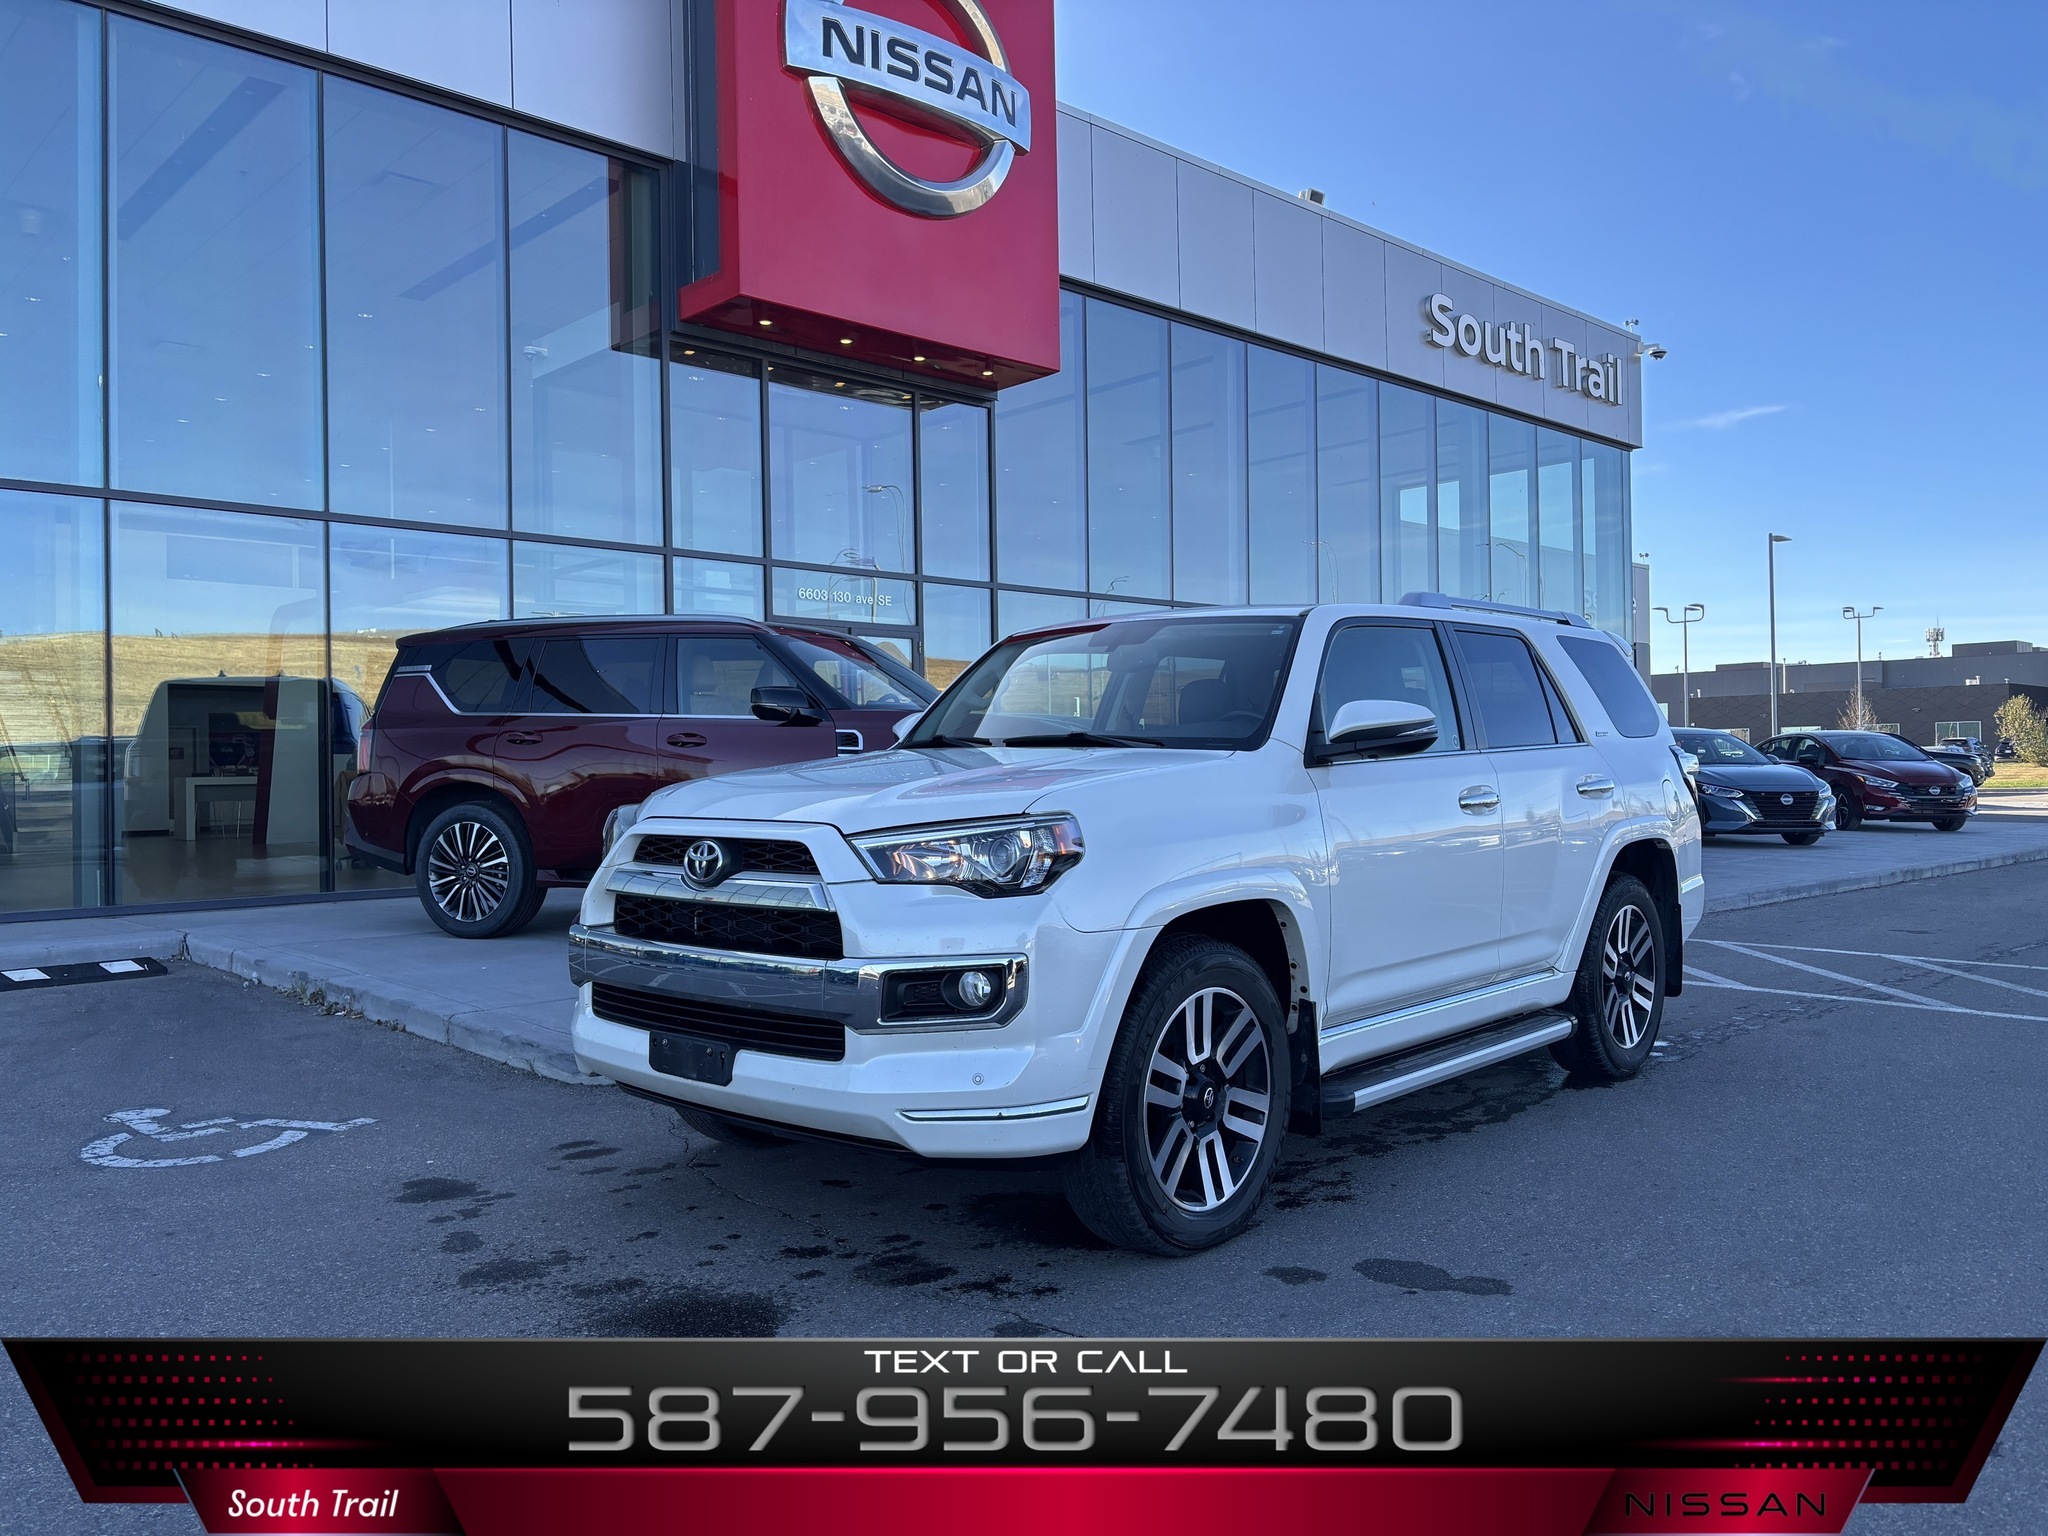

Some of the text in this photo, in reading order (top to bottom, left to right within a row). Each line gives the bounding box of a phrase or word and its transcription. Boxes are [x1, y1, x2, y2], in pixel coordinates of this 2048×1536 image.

[822, 16, 1018, 128] NISSAN
[1426, 292, 1623, 406] South Trail
[798, 587, 892, 606] 6603 130 ave SE
